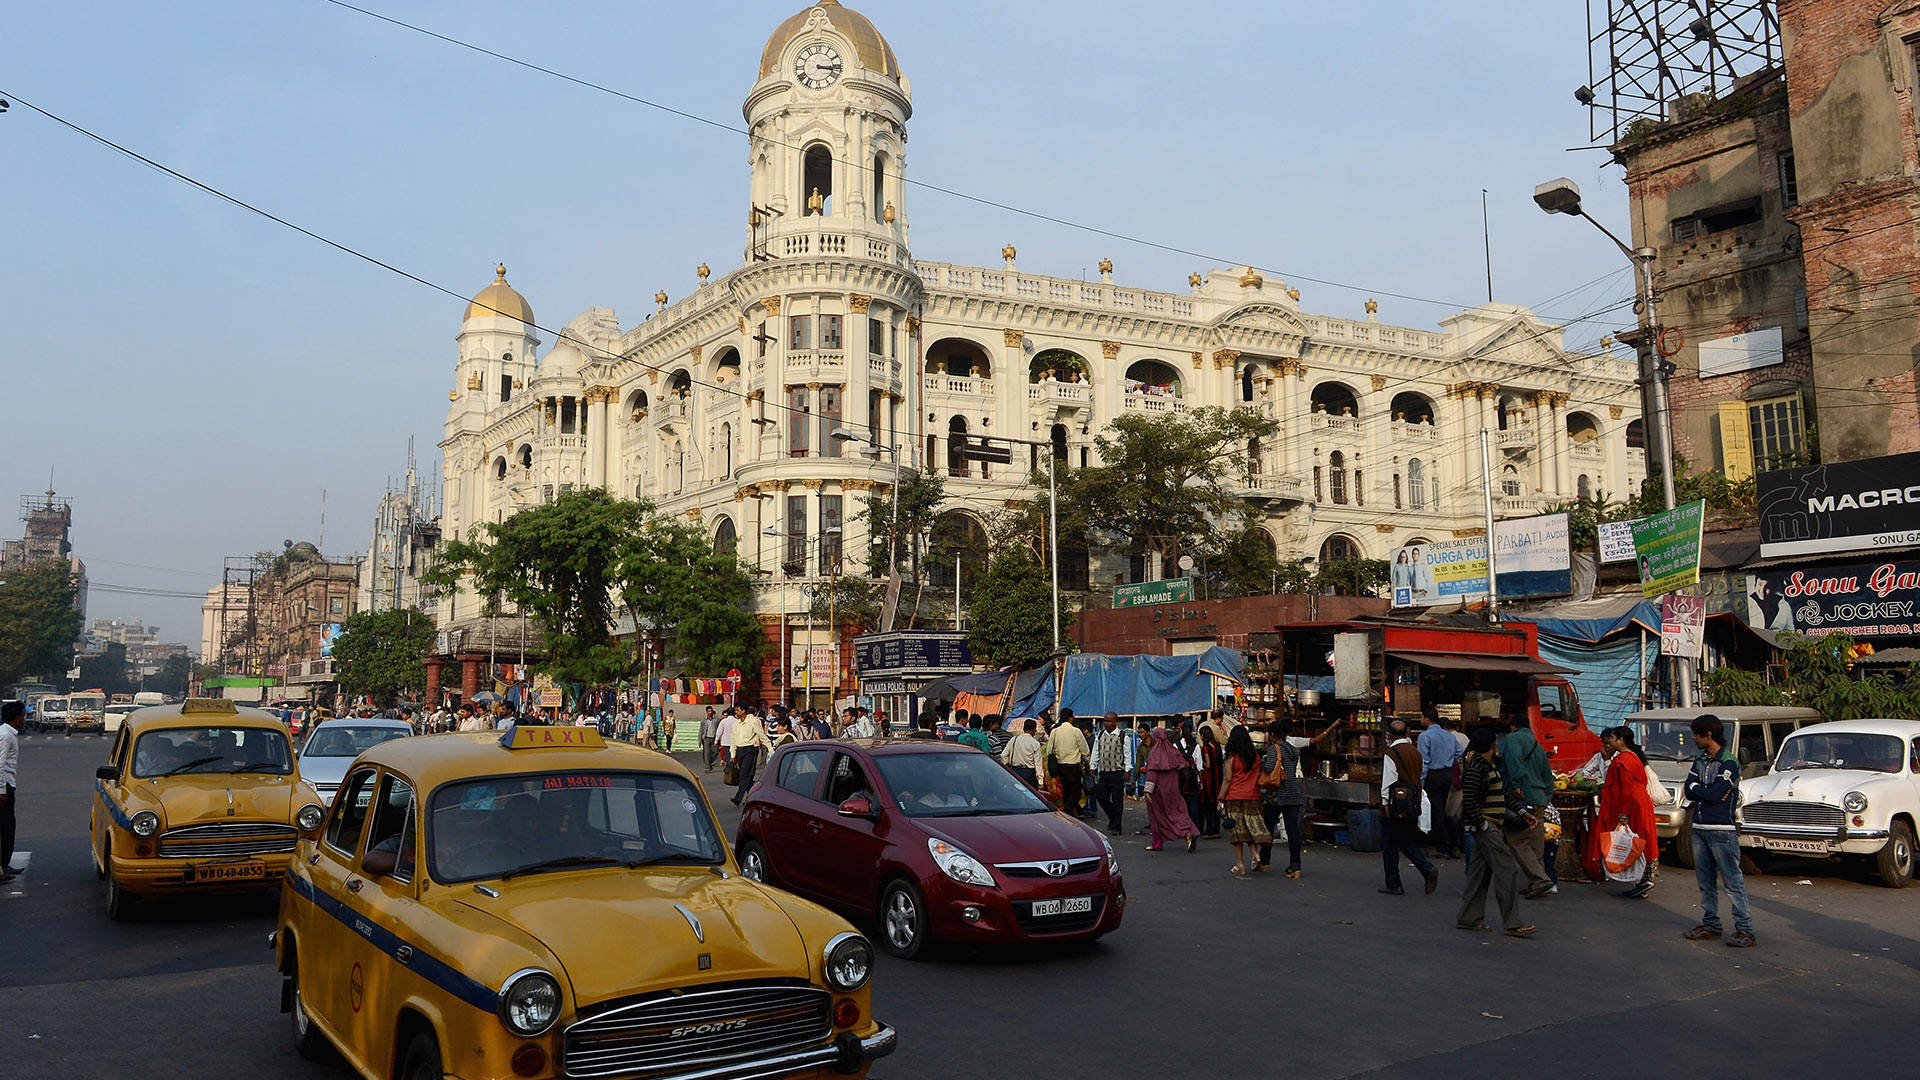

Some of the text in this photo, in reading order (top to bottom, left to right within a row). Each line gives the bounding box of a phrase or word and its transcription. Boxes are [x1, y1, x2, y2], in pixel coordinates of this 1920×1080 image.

[1429, 541, 1452, 552] SPECIAL
[1453, 539, 1467, 548] SALE
[1873, 533, 1904, 545] SONU
[1426, 550, 1464, 565] DURGA
[1785, 571, 1860, 597] Sonu
[1133, 592, 1172, 605] ESPLANADE
[1662, 637, 1680, 655] 20
[865, 683, 887, 693] KOLKATA
[887, 681, 906, 692] POLICE
[525, 729, 585, 744] TAXI
[544, 777, 563, 790] JAI
[567, 775, 598, 789] MATA
[1066, 900, 1089, 912] 2650
[669, 1019, 748, 1039] SPORTS
